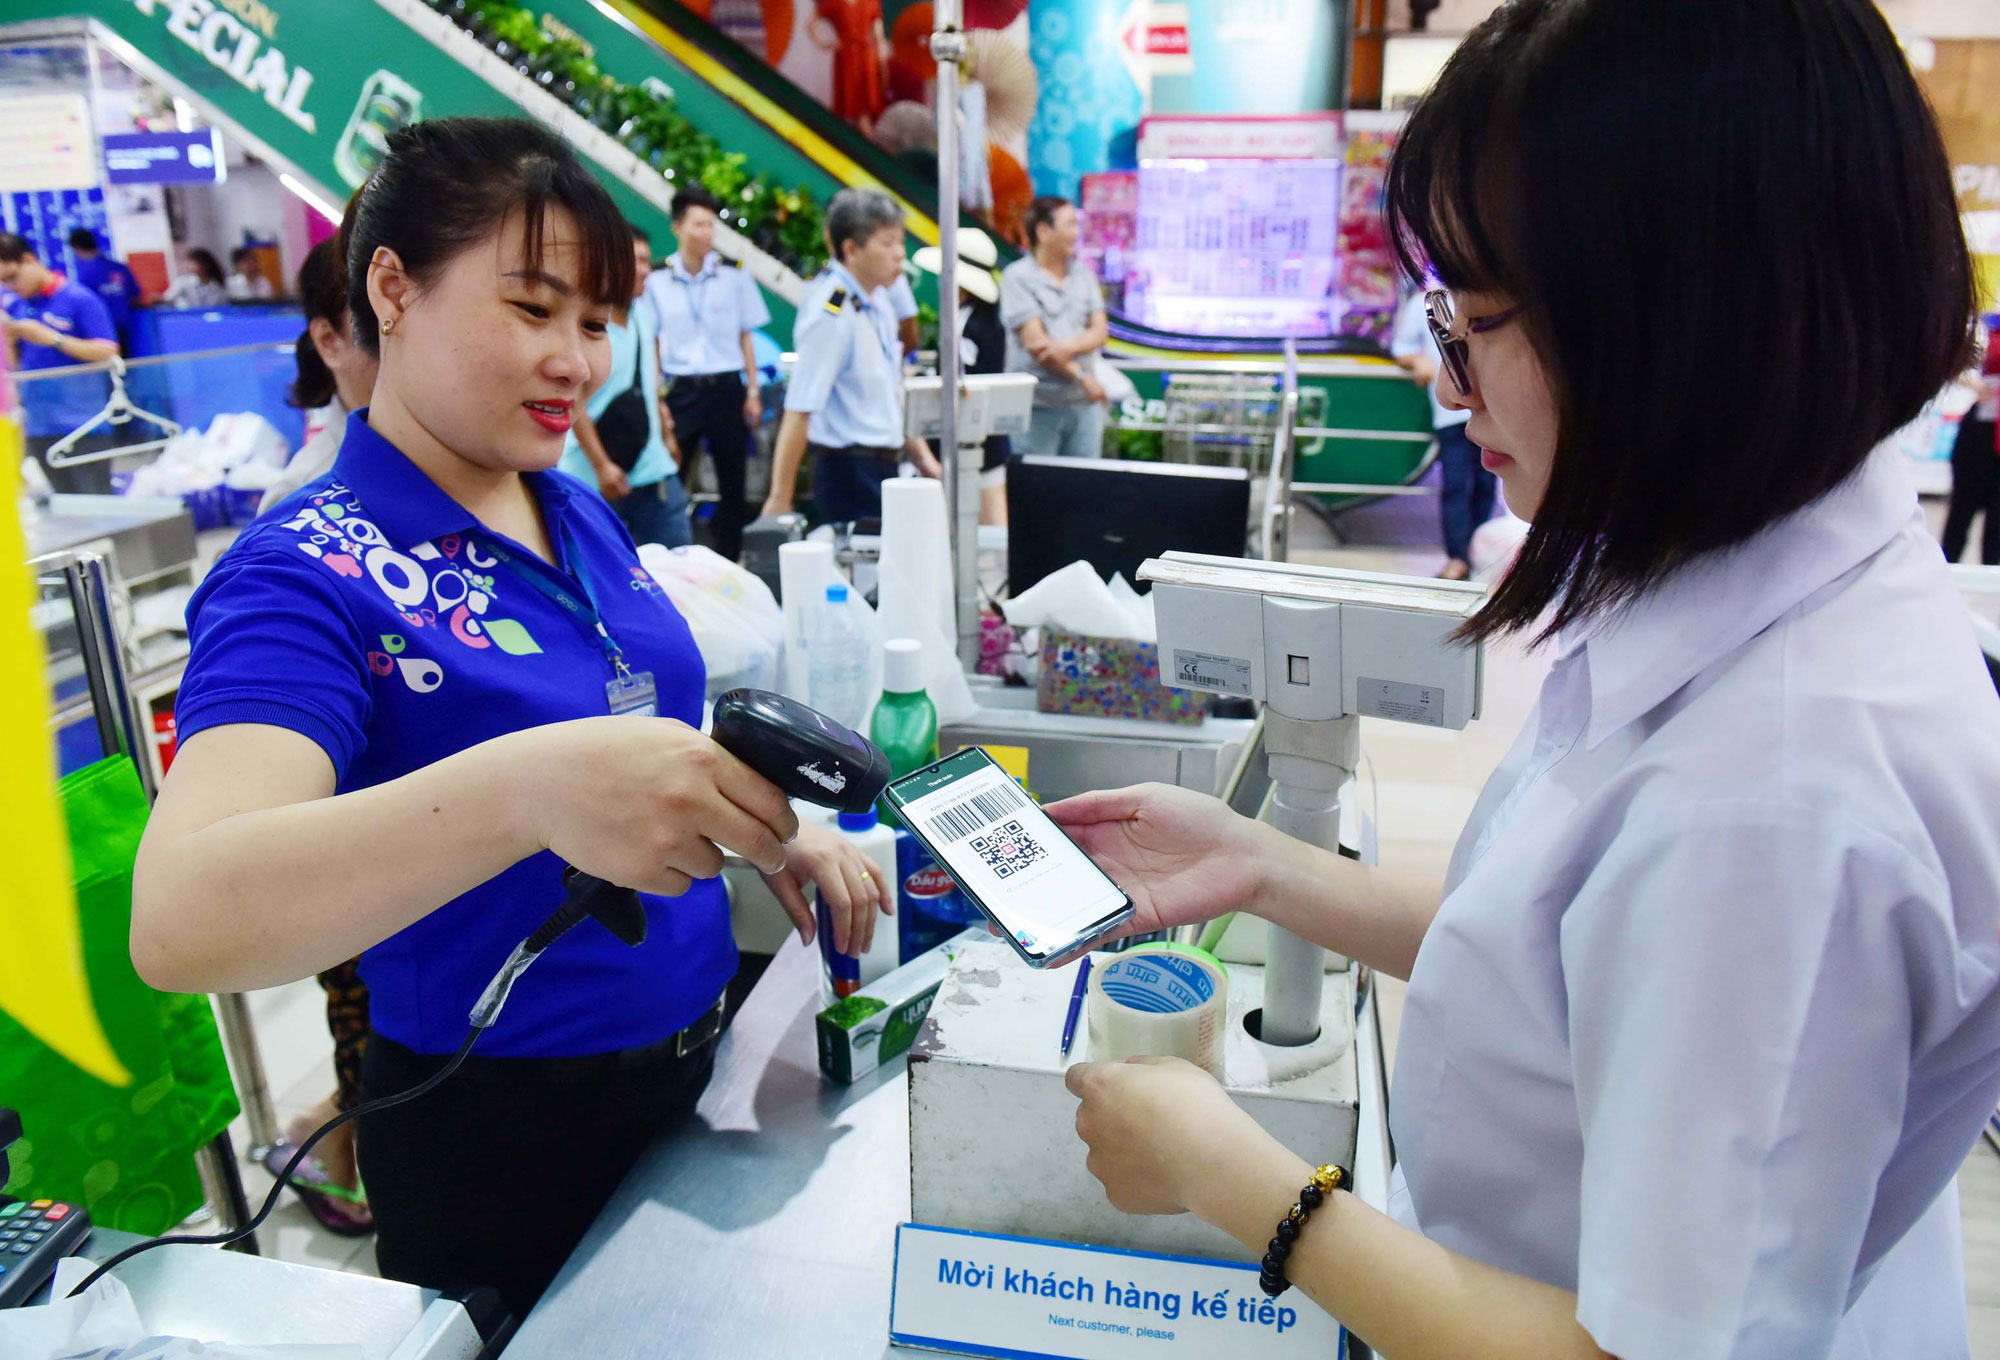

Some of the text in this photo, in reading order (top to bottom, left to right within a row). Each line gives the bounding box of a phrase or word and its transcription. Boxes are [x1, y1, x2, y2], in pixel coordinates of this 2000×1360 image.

[938, 1258, 1296, 1333] Mời khách hàng kế tiếp
[1048, 1313, 1175, 1341] Next customer, please
